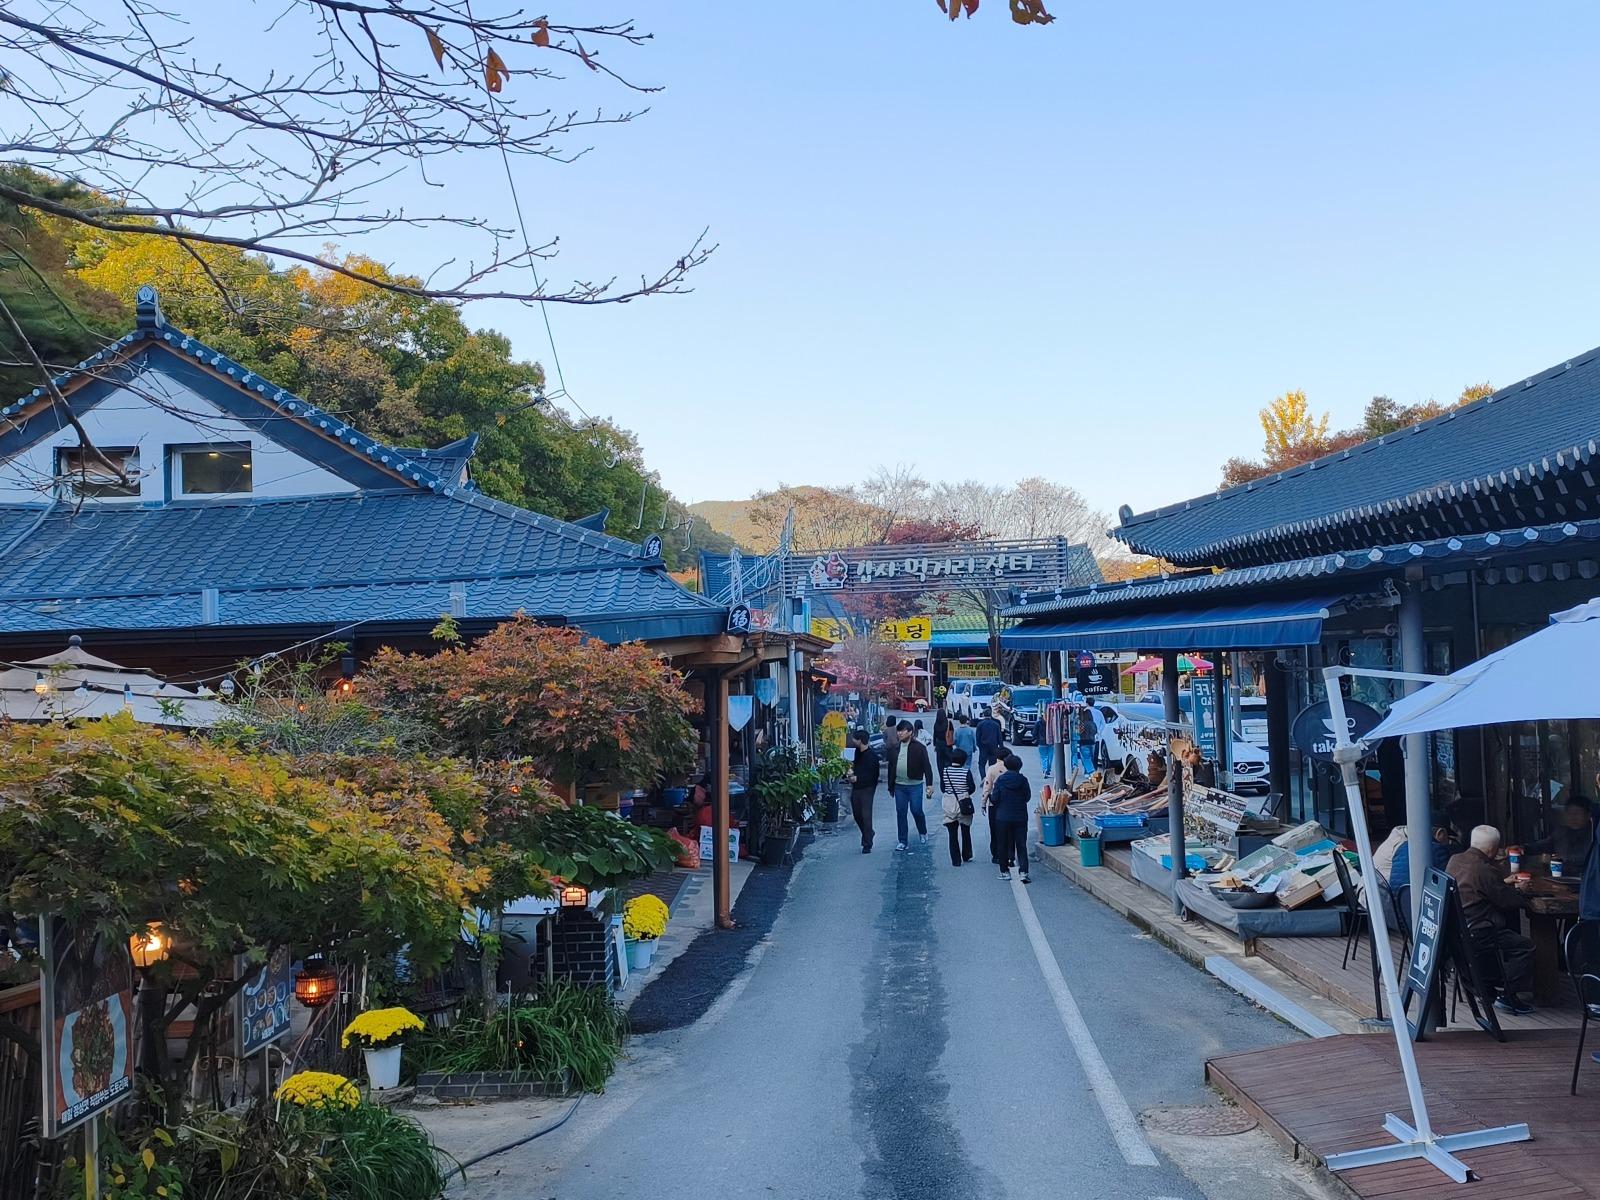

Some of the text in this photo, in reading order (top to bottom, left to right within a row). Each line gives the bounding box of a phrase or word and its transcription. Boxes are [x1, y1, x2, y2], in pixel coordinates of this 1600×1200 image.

[857, 553, 1033, 583] 갑사 먹거리 장터
[732, 609, 748, 627] 福
[1084, 685, 1109, 693] coffee
